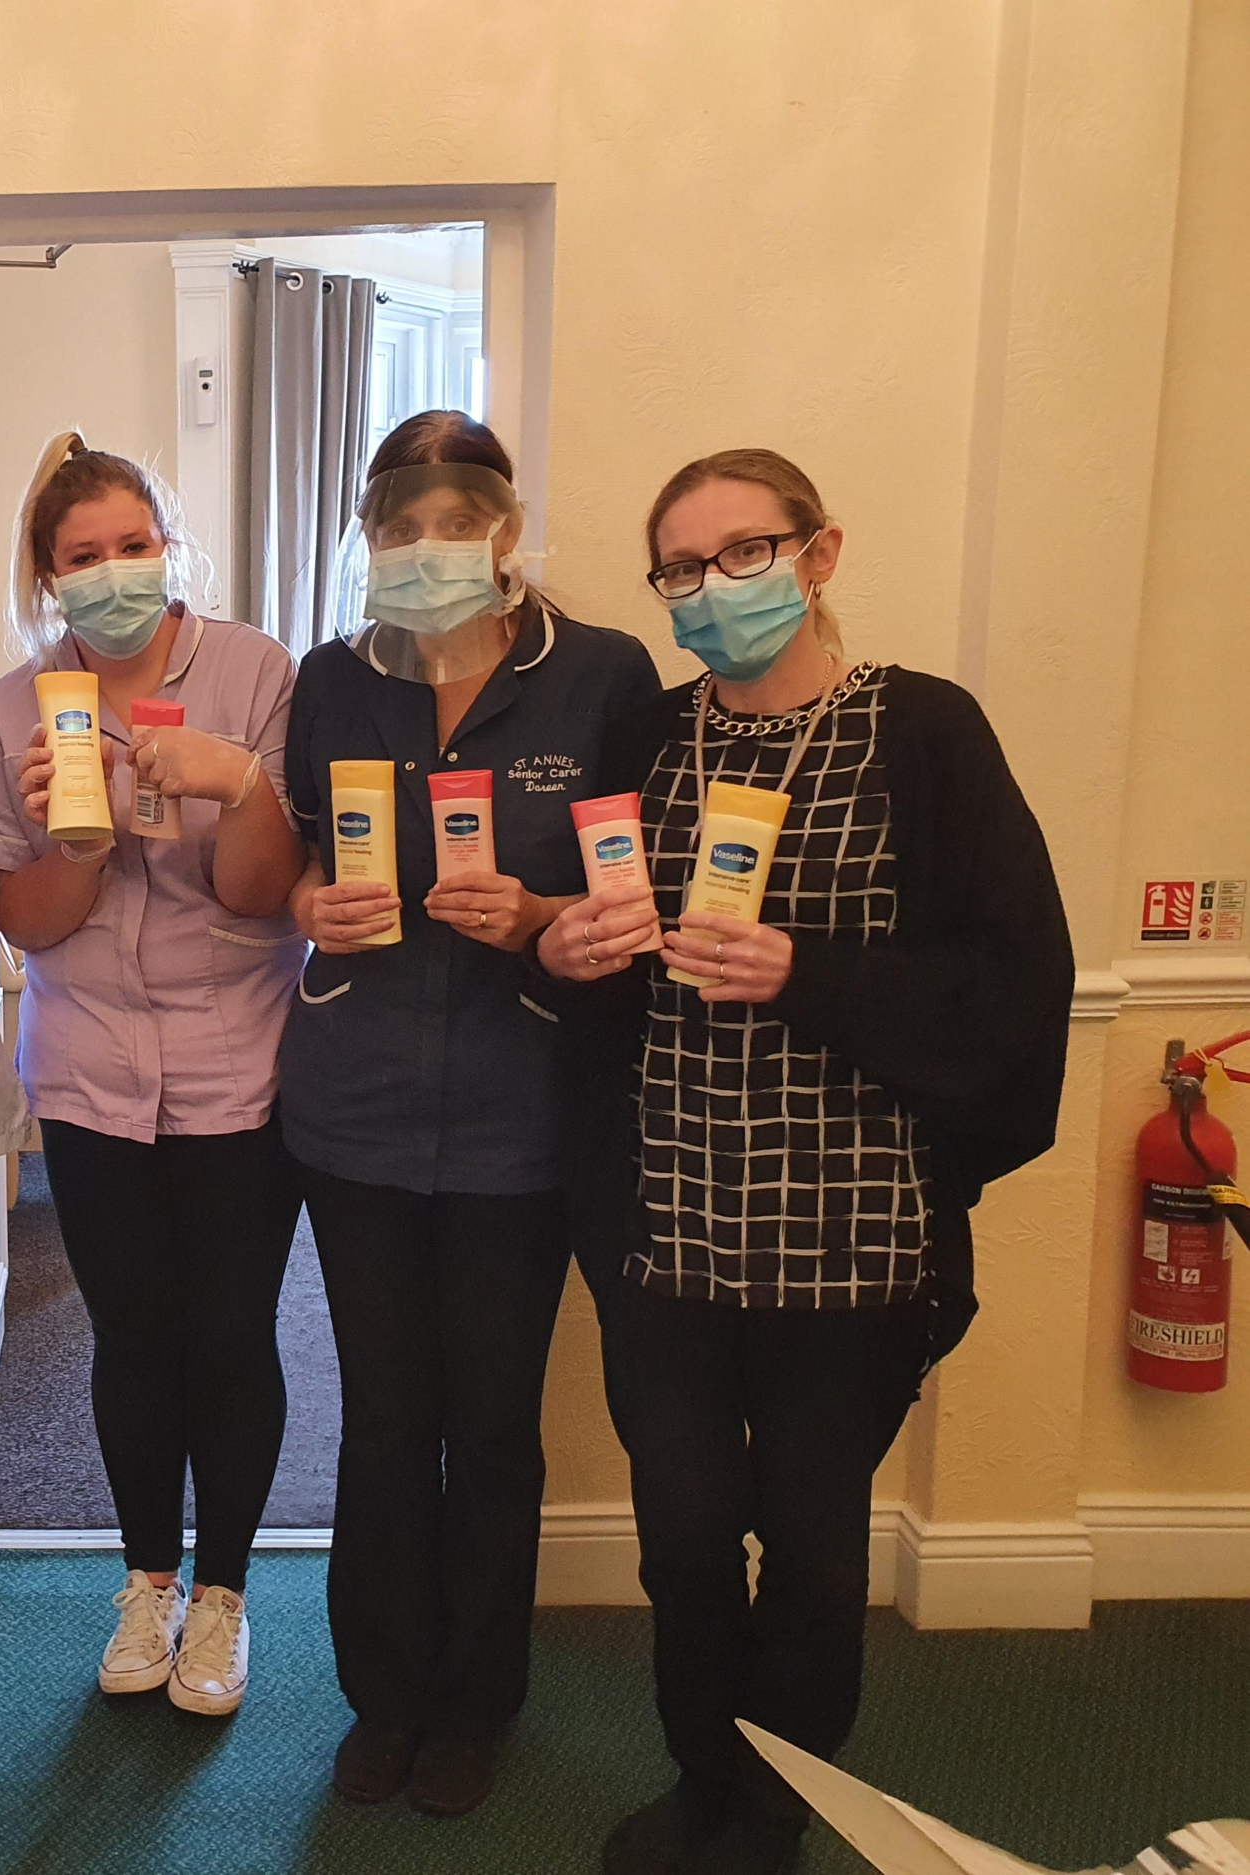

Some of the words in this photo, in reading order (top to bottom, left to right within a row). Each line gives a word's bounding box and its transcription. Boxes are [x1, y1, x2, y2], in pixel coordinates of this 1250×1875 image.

[514, 758, 527, 770] ST
[533, 754, 575, 768] ANNES
[507, 769, 544, 779] Senior
[549, 768, 583, 778] Carer
[337, 819, 369, 828] Vaseline
[445, 820, 478, 828] Vaseline
[596, 842, 632, 852] Vaseline
[713, 848, 755, 864] Vaseline
